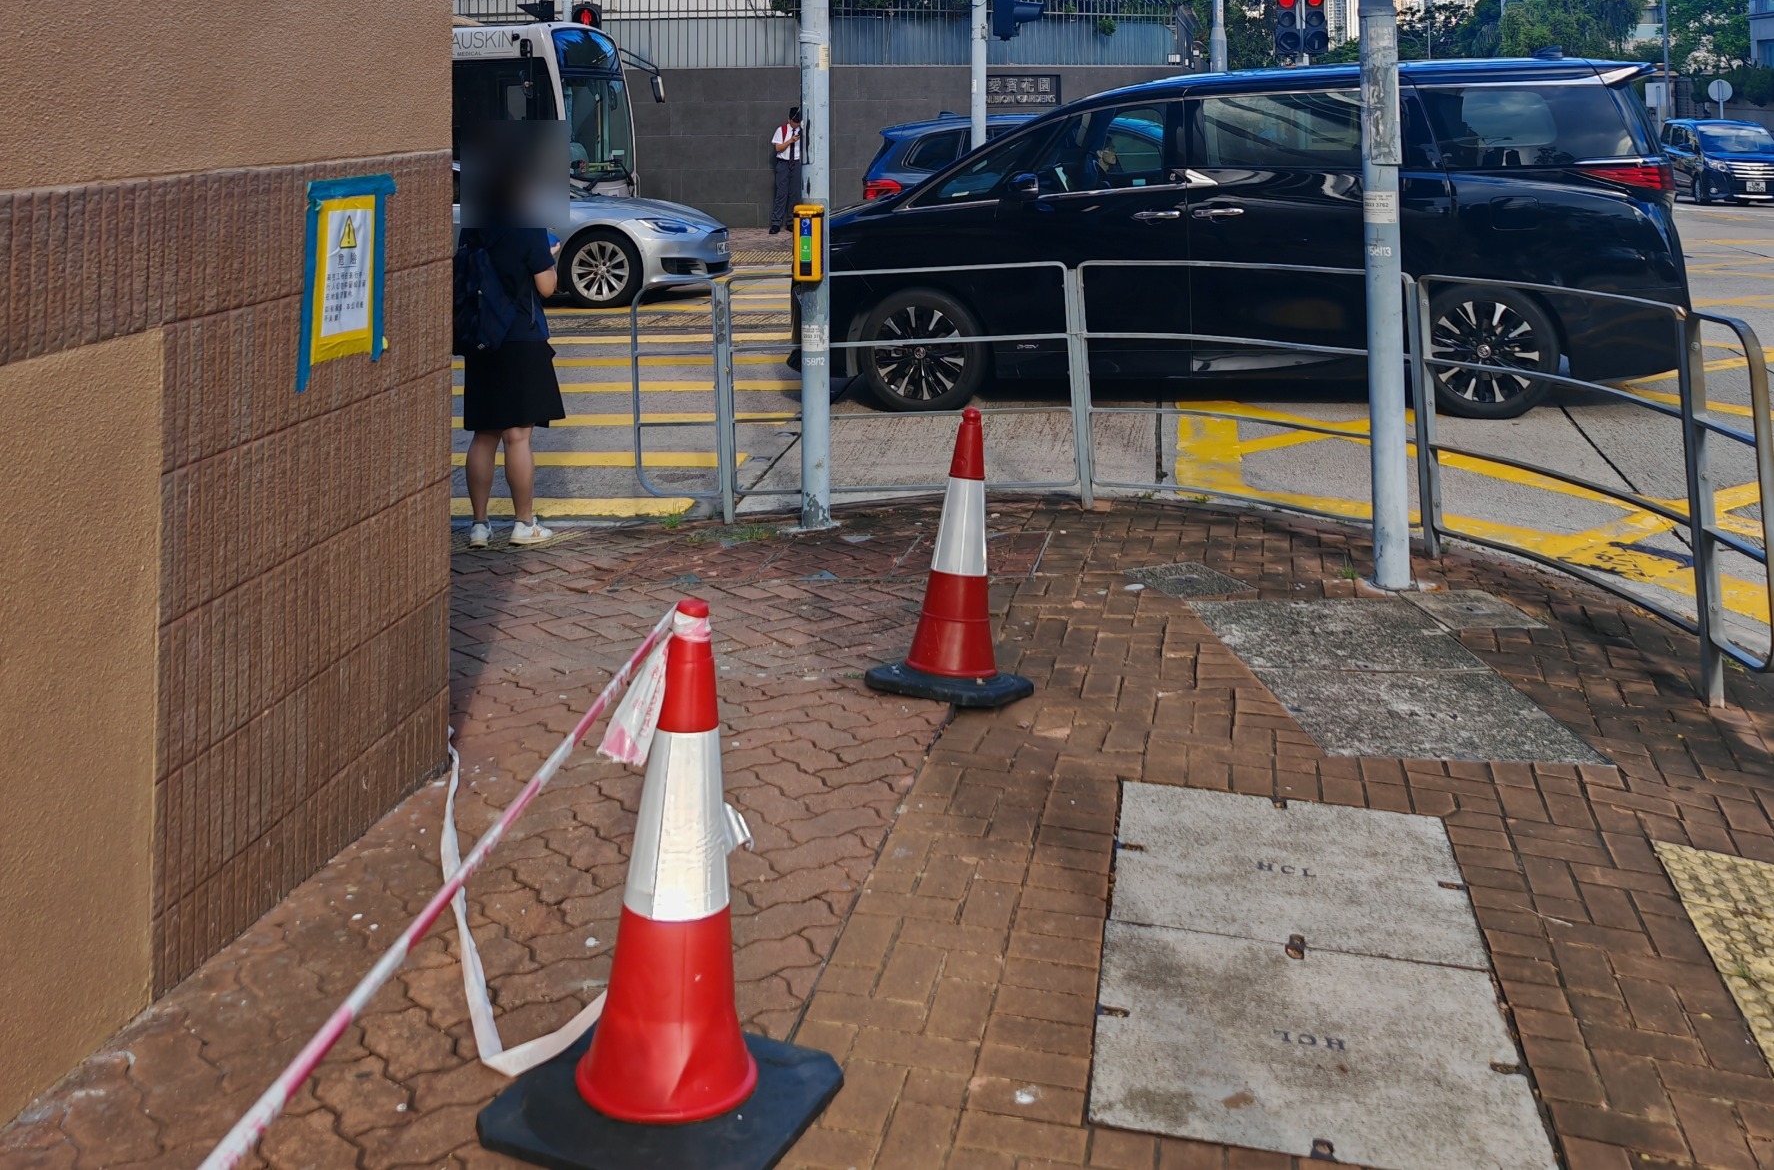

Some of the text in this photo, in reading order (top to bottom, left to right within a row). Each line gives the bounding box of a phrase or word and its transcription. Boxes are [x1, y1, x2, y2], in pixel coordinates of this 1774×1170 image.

[988, 78, 1051, 92] 愛賓花園
[1016, 94, 1056, 103] GARDENS
[1256, 860, 1317, 878] HCL
[1272, 1028, 1346, 1051] HCL
